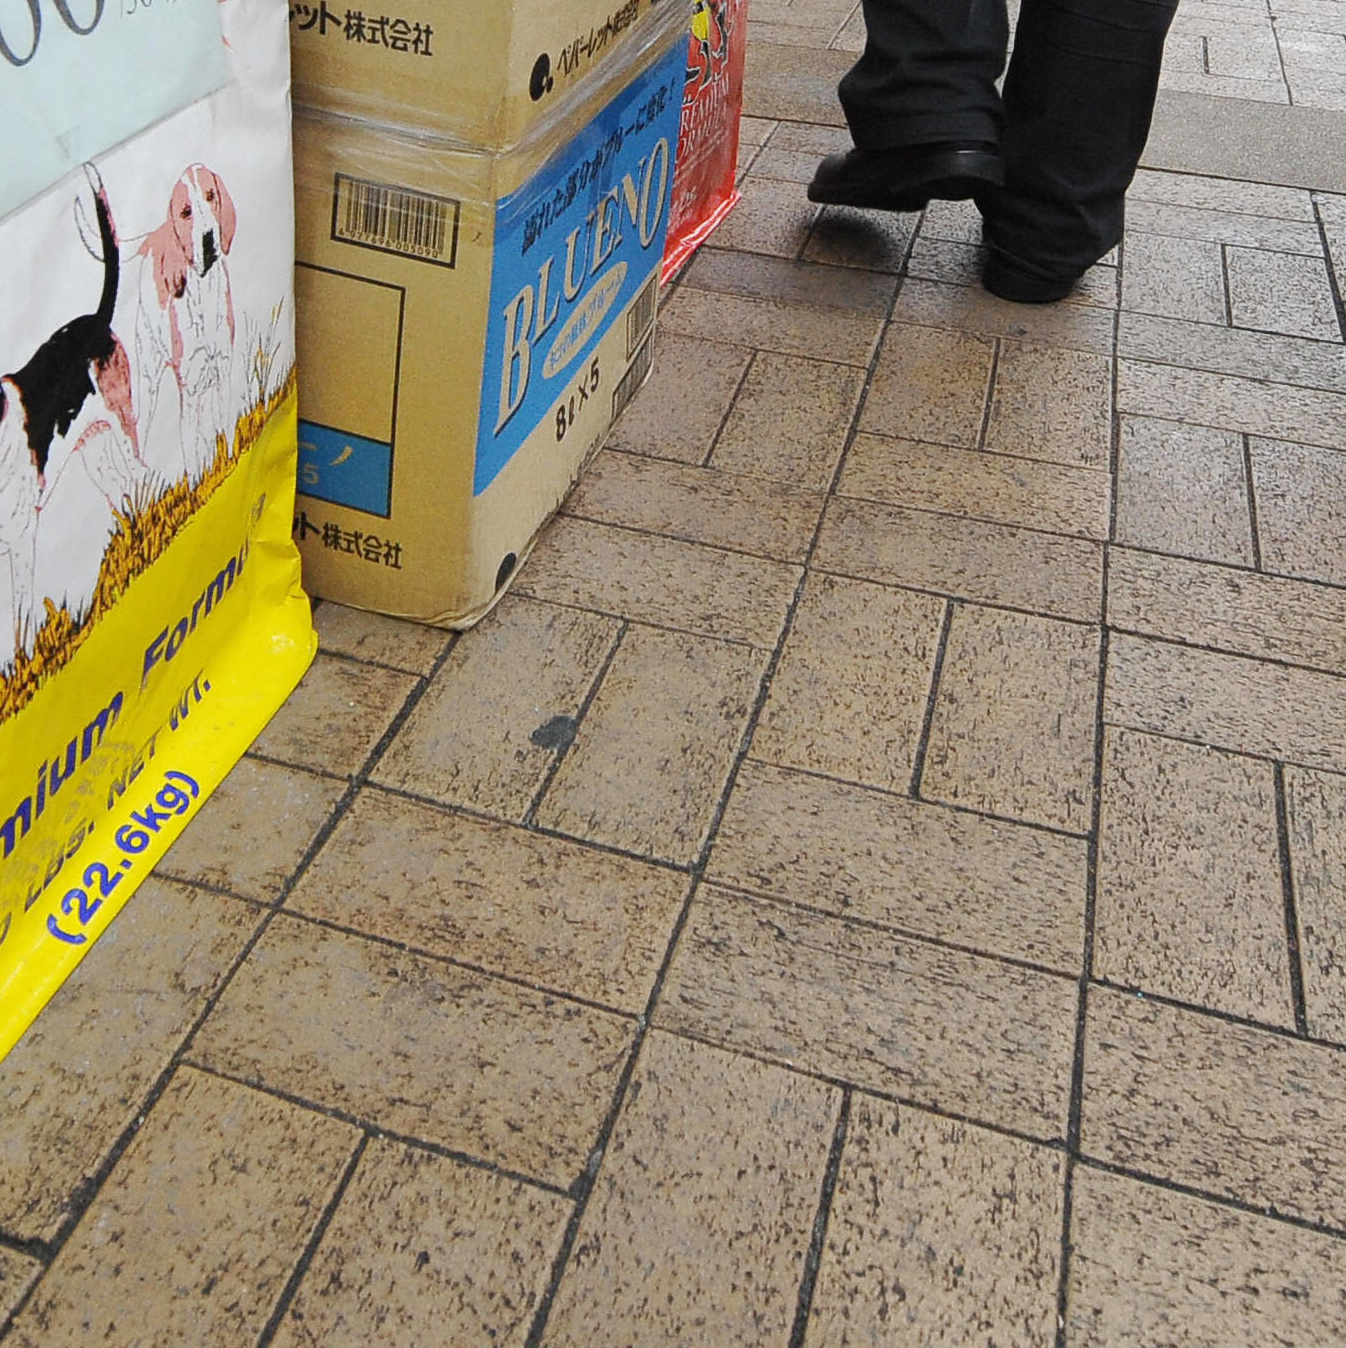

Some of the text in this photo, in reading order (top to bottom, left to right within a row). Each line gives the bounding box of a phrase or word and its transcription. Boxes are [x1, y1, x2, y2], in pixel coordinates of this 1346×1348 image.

[679, 70, 731, 137] REMIUM
[493, 136, 670, 438] BLUENO
[46, 769, 201, 946] (22.6kg)
